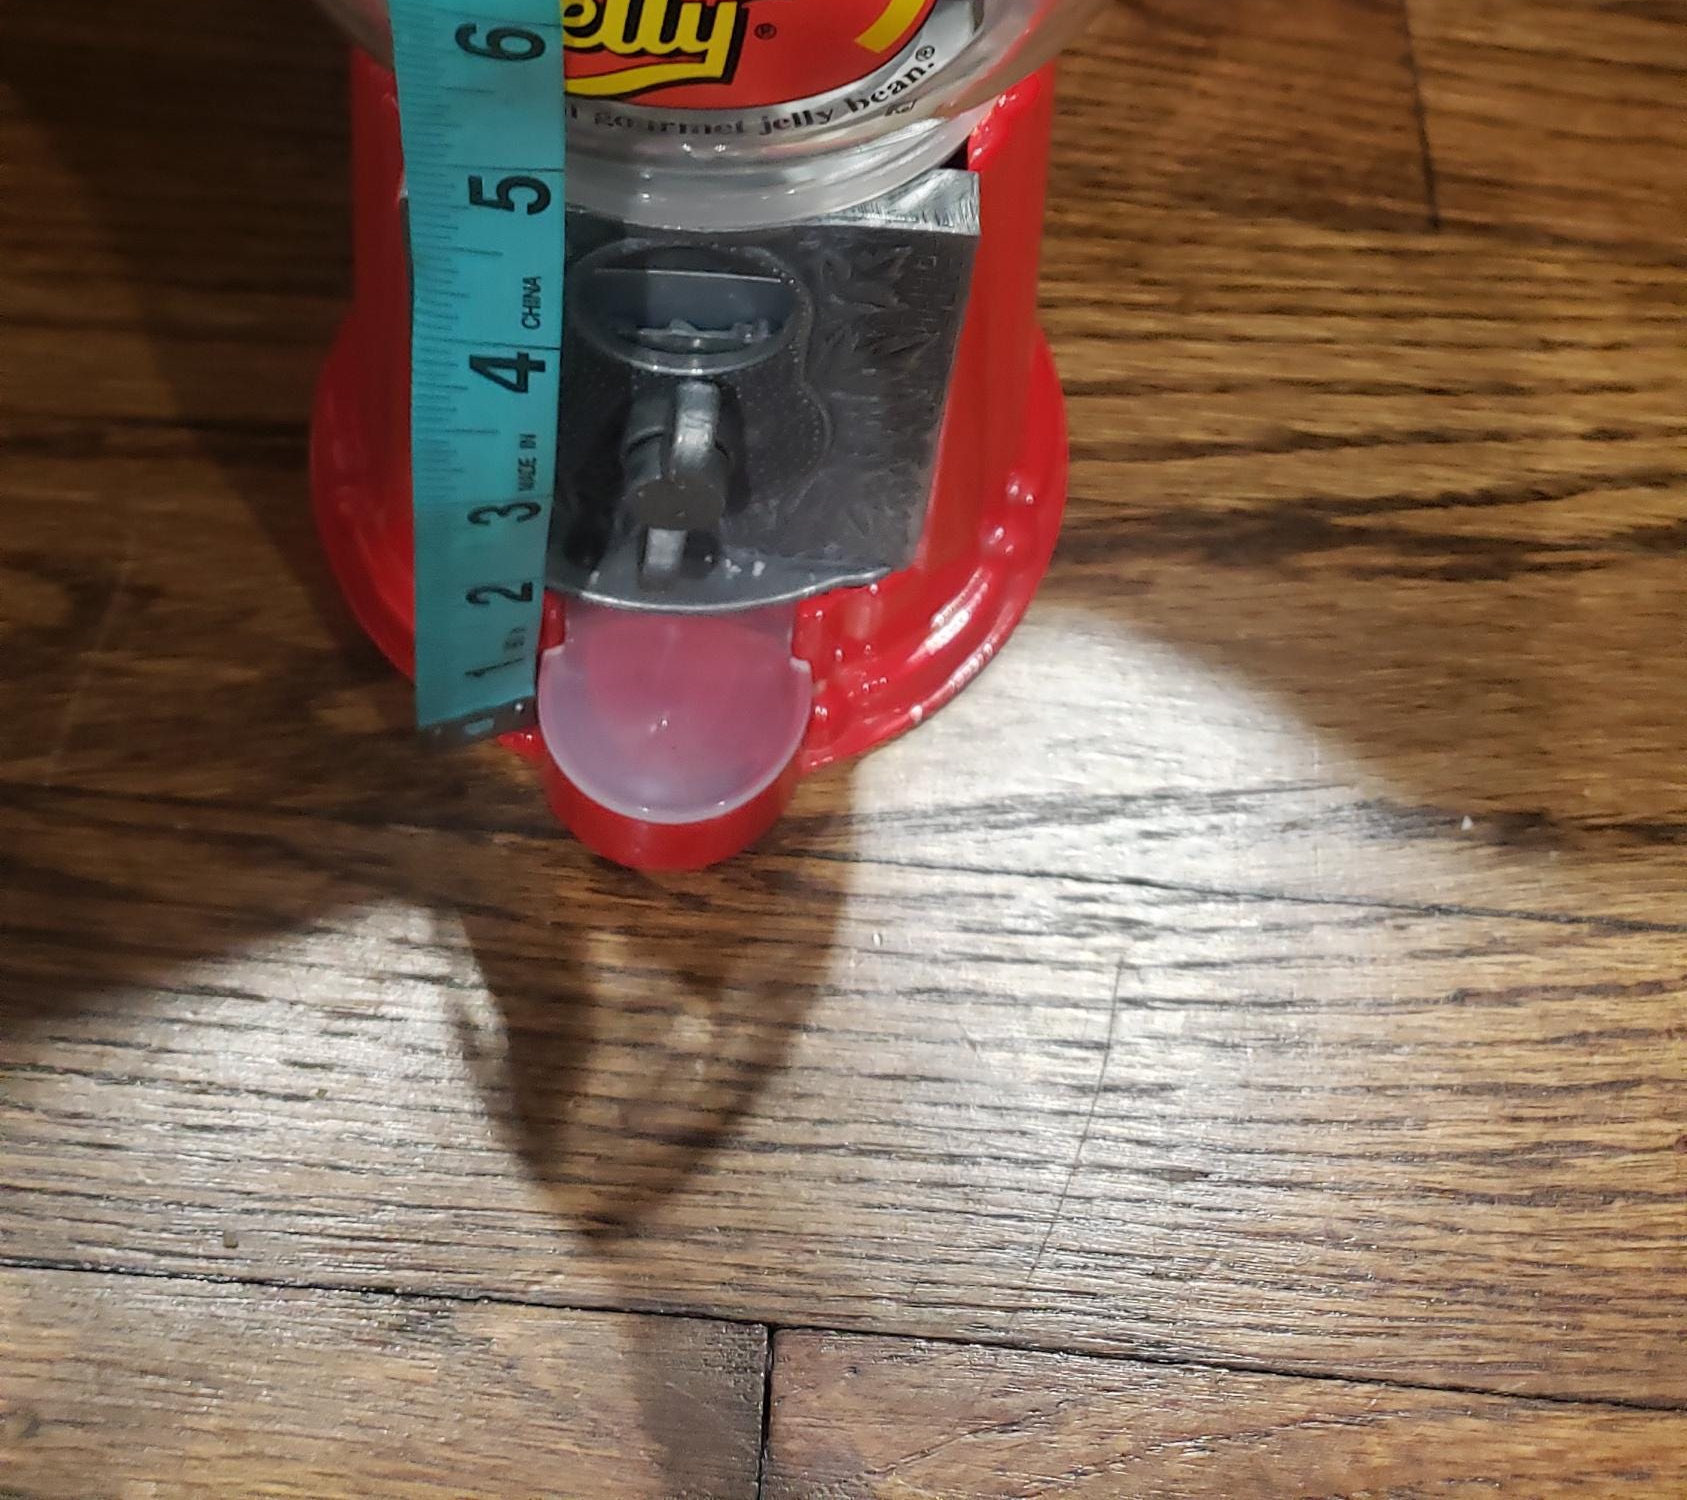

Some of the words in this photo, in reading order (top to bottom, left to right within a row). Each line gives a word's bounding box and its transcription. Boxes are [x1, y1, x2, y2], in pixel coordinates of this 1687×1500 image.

[455, 23, 546, 62] 6
[760, 108, 834, 135] jelly
[468, 175, 551, 215] 5
[521, 276, 541, 329] CHINA
[469, 352, 546, 393] 4
[519, 433, 537, 449] IN
[518, 457, 537, 492] MADE
[467, 502, 541, 525] 3
[466, 581, 533, 605] 2
